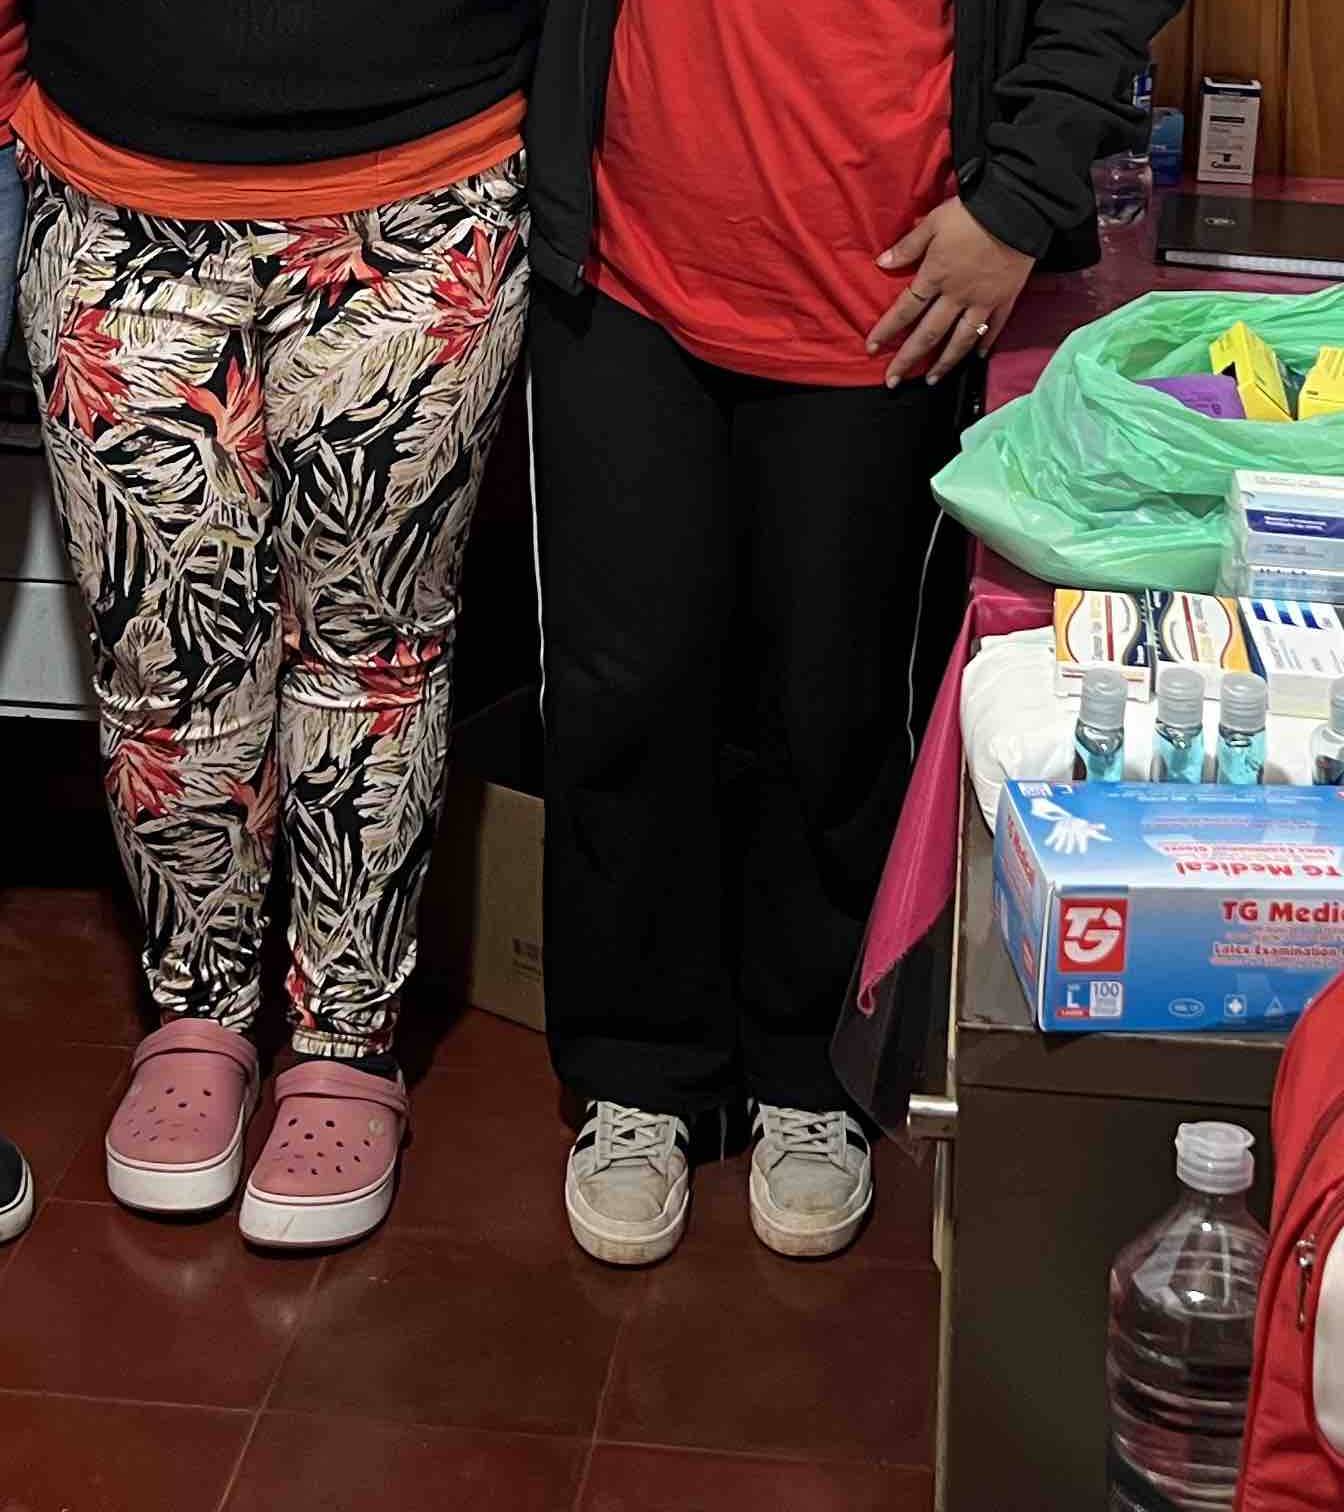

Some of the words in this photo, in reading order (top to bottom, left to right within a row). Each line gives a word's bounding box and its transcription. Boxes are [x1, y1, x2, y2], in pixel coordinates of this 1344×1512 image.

[1175, 861, 1295, 877] Medical
[1222, 901, 1259, 922] TG
[1093, 981, 1120, 997] 100
